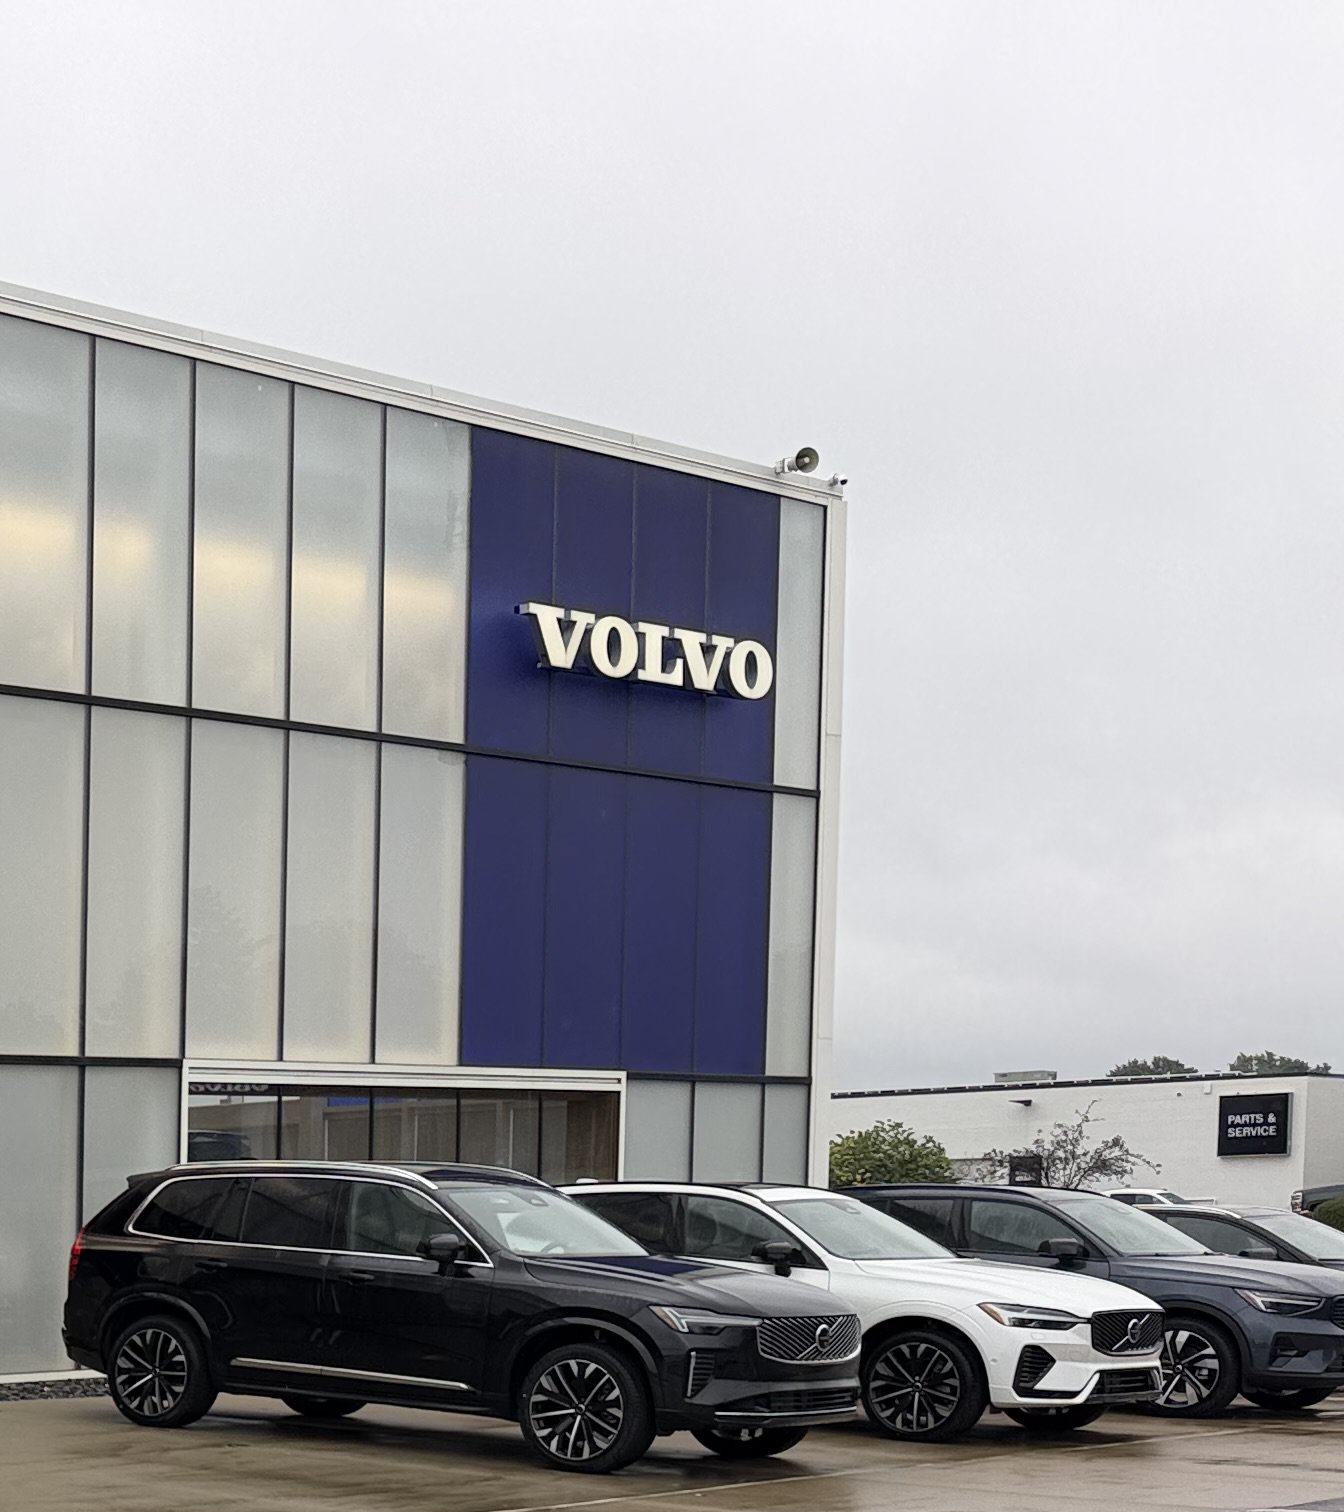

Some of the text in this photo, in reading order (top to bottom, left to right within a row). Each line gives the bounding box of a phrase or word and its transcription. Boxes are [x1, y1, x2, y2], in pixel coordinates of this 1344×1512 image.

[522, 602, 774, 699] VOLVO
[1227, 1112, 1277, 1125] PARTS &
[1227, 1125, 1278, 1138] SERVICE
